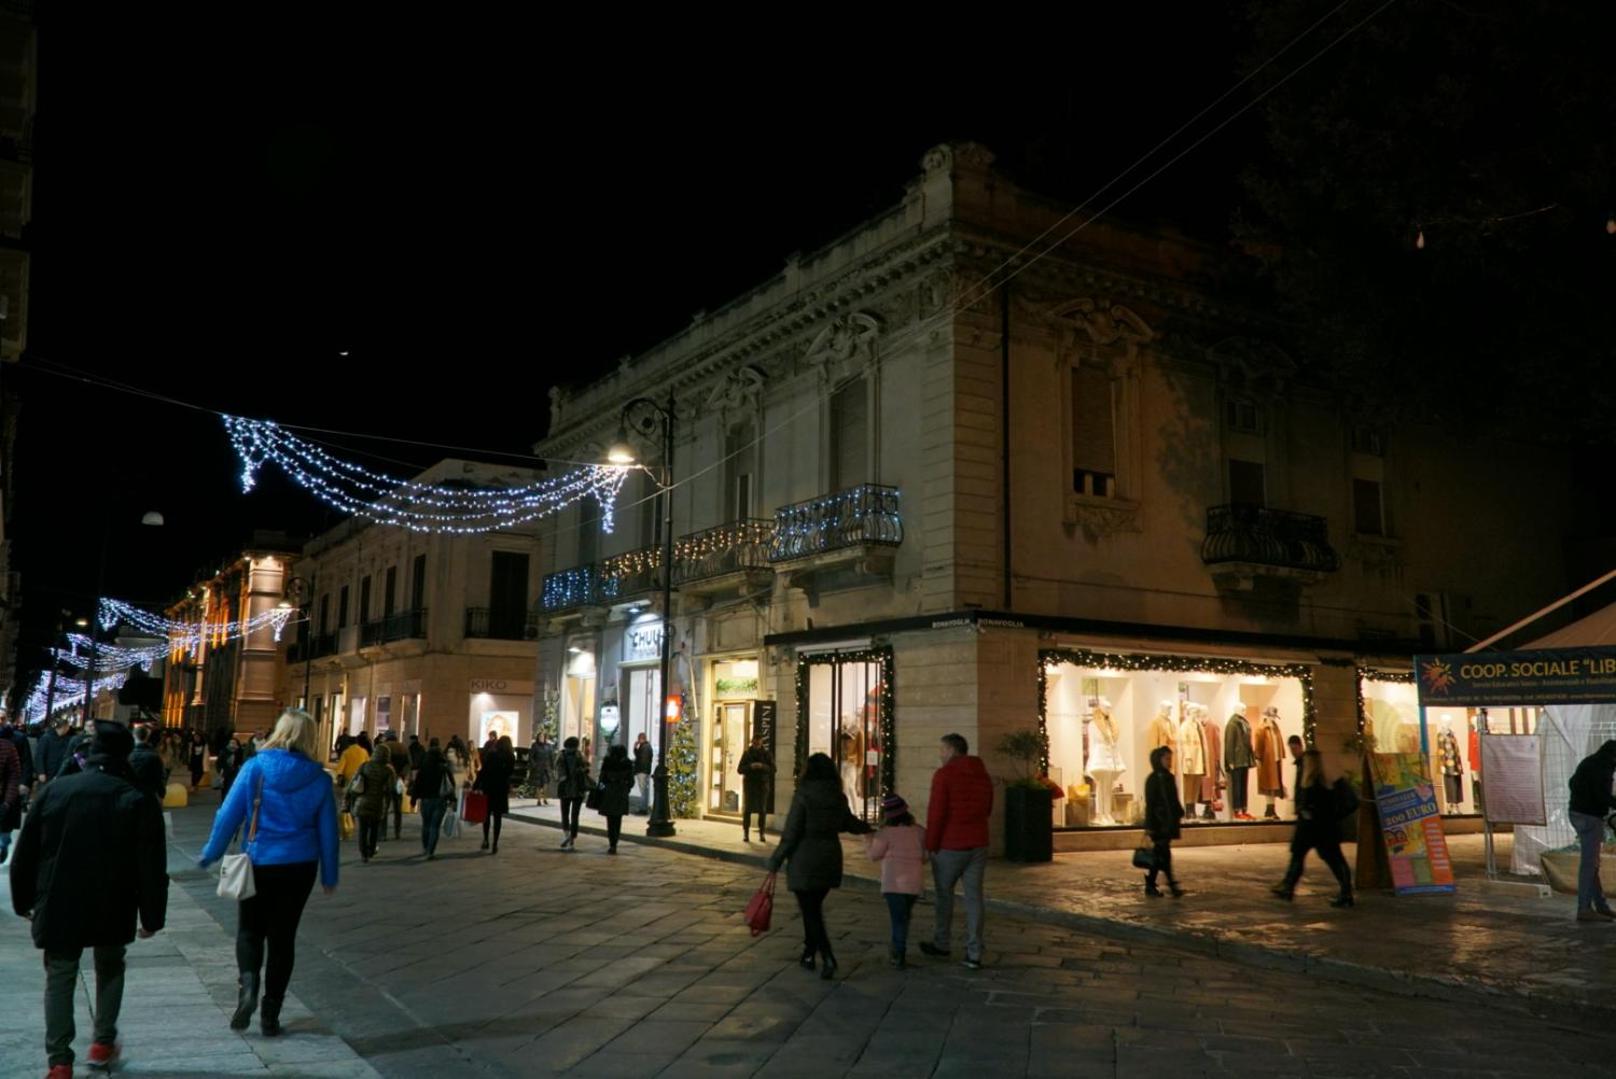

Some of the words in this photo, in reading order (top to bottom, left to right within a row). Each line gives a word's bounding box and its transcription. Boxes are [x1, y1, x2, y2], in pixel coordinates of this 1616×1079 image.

[1460, 664, 1508, 680] COOP.
[1511, 660, 1580, 678] SOCIALE
[471, 679, 506, 690] KIKO
[1405, 802, 1437, 820] EURO
